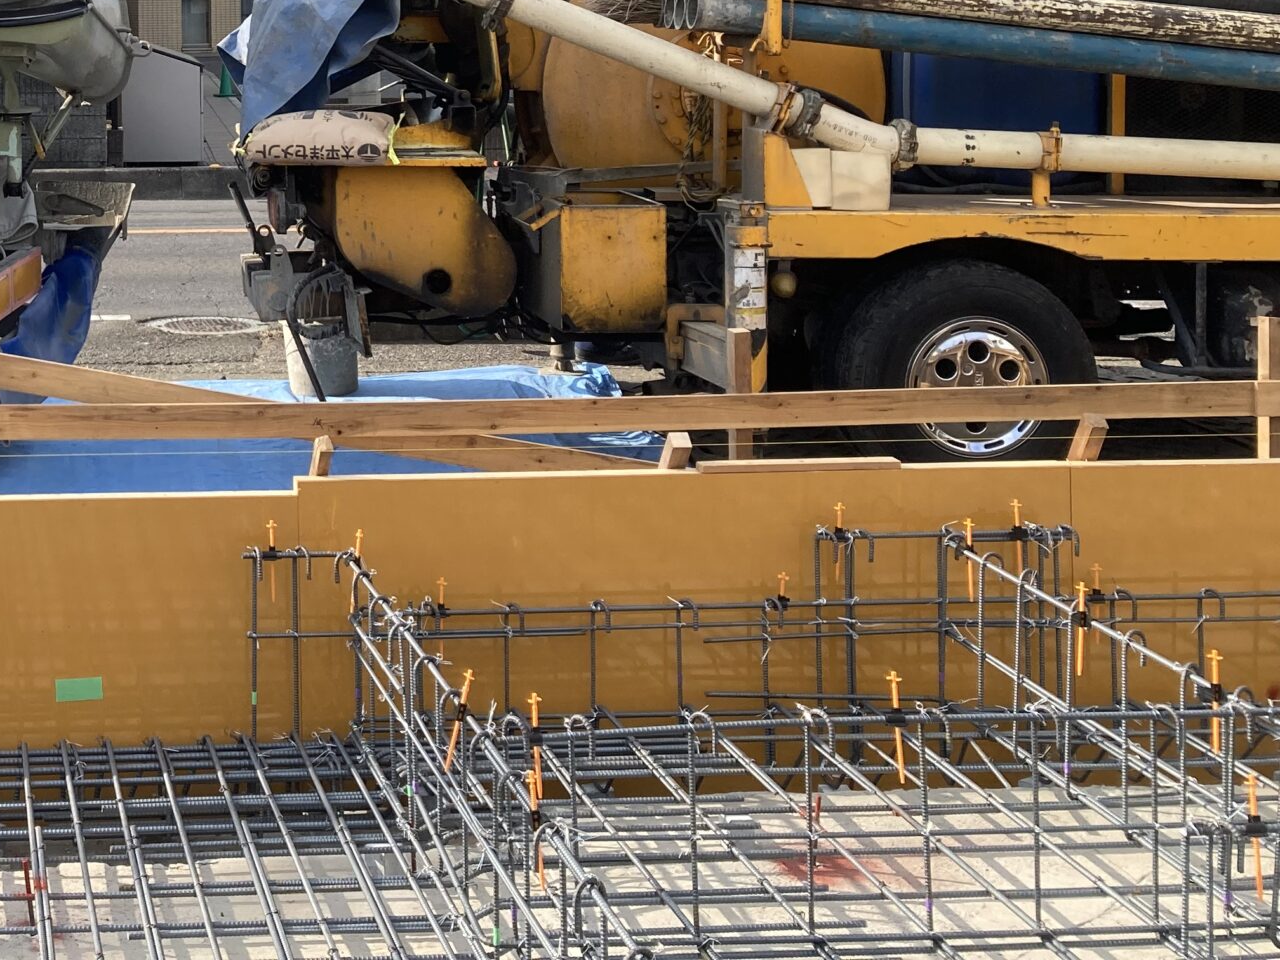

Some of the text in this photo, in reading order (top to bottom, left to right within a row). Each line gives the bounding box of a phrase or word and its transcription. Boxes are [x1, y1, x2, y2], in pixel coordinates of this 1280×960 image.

[255, 144, 354, 160] 太平洋セメント
